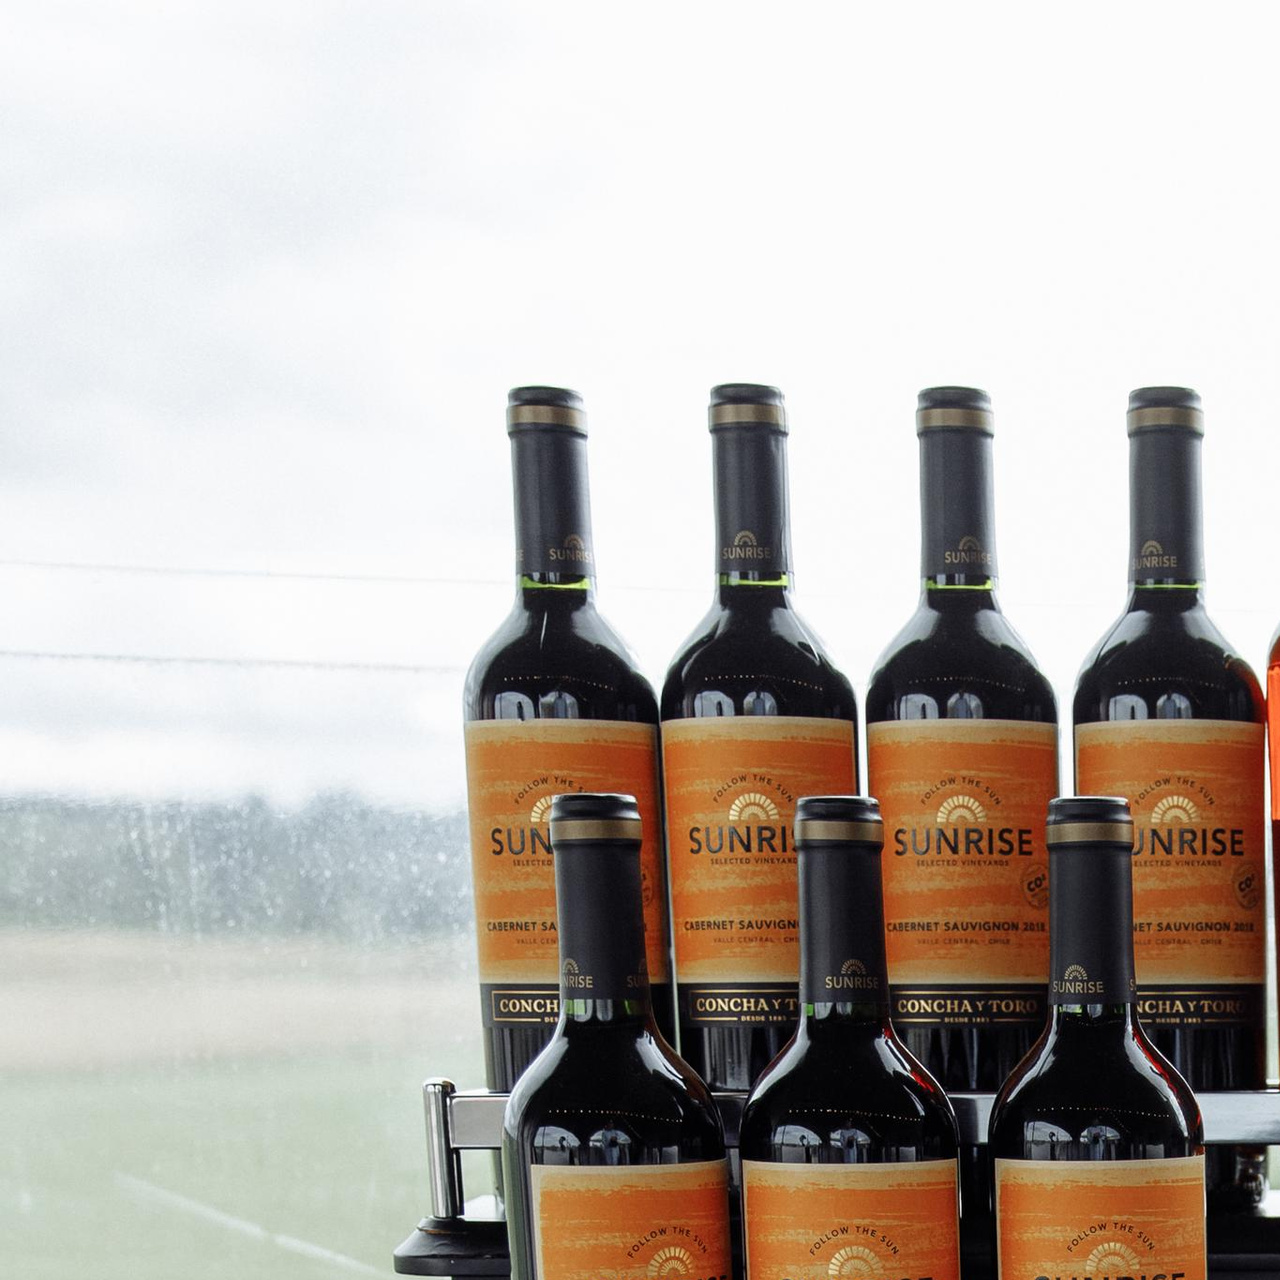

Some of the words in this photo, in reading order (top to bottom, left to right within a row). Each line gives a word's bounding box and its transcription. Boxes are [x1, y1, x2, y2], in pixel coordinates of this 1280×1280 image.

[723, 548, 771, 560] SUNRISE
[945, 551, 992, 565] SUNRISE
[1132, 556, 1177, 570] SUNRISE
[514, 777, 549, 805] FOLLOW
[554, 776, 574, 788] THE
[713, 775, 747, 803] FOLLOW
[753, 774, 772, 785] THE
[776, 783, 793, 803] SUN
[921, 777, 957, 804] FOLLOW
[961, 777, 981, 788] THE
[984, 786, 1001, 804] SUN
[1135, 778, 1171, 805] FOLLOW
[1177, 777, 1196, 787] THE
[895, 828, 1032, 856] SUNRISE
[1132, 829, 1244, 855] UNRISE
[487, 921, 537, 932] CABERNET
[684, 920, 734, 930] CABERNET
[887, 923, 939, 932] CABERNET
[944, 922, 1019, 931] SAUVIGNON
[1157, 922, 1230, 932] SAUVIGNON
[825, 976, 878, 989] SUNRISE
[1053, 981, 1104, 993] SUNRISE
[500, 999, 559, 1013] CONCH
[697, 998, 767, 1012] CONCHA
[772, 999, 781, 1010] Y
[899, 1000, 973, 1012] CONCHA
[977, 1002, 985, 1012] Y
[986, 1000, 1037, 1012] TORO
[1188, 1002, 1195, 1012] Y
[627, 1227, 667, 1258] FOLLOW
[672, 1227, 691, 1238] THE
[693, 1234, 708, 1253] SUN
[809, 1226, 850, 1256] FOLLOW
[855, 1226, 877, 1238] THE
[880, 1236, 899, 1255] SUN
[1067, 1223, 1107, 1252] FOLLOW
[1113, 1223, 1134, 1234] THE
[1137, 1232, 1154, 1251] SUN
